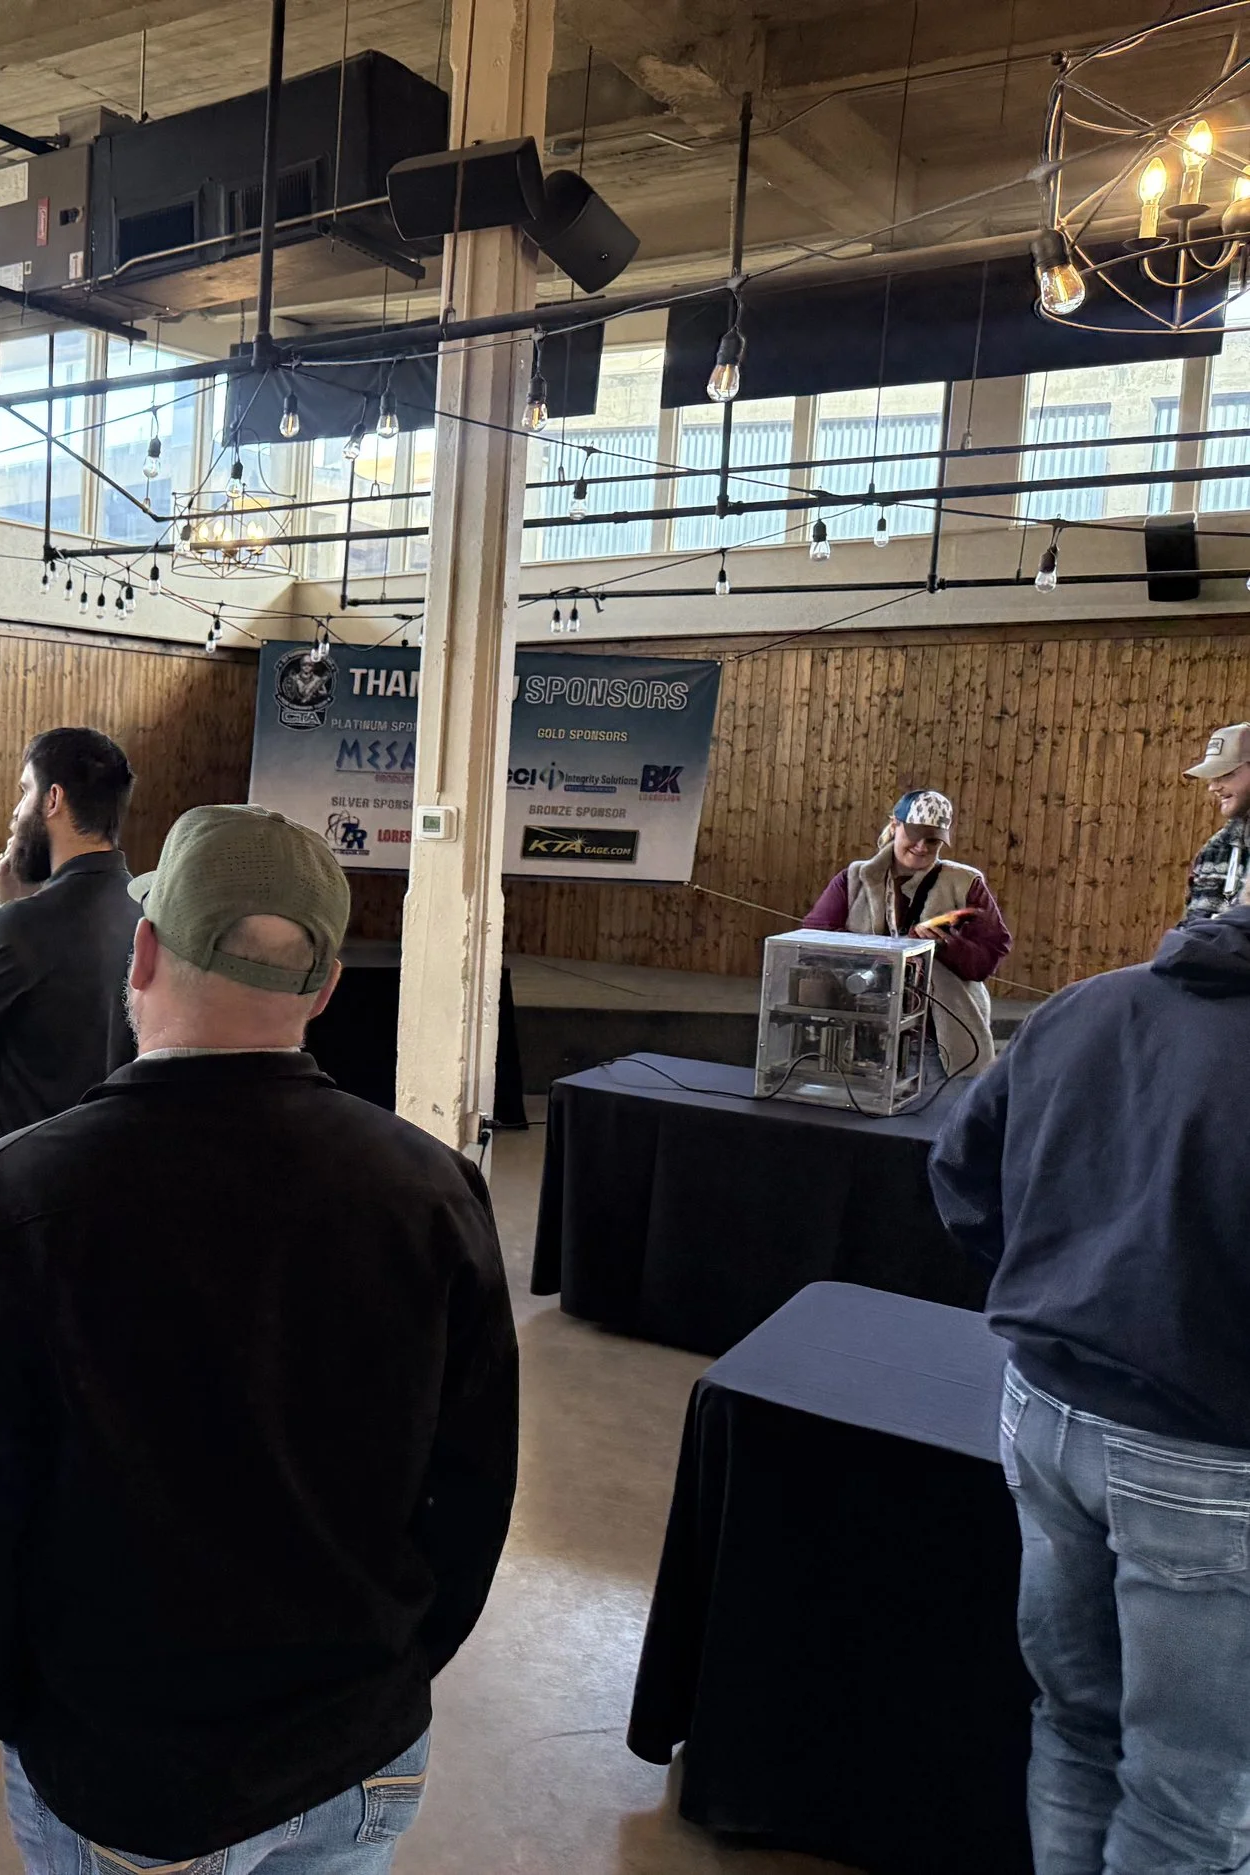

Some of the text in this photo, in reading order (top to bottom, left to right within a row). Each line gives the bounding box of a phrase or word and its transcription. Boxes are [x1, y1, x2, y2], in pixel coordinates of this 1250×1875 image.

[525, 675, 688, 710] SPONSORS
[331, 718, 387, 731] PLATINUM
[537, 728, 628, 742] GOLD SPONSORS
[565, 773, 638, 785] Integrity Solutions
[640, 764, 684, 793] BK
[331, 796, 413, 810] SILVER SPONS
[529, 804, 627, 818] BRONZE SPONSOR
[529, 840, 631, 855] KTA GAGE.COM
